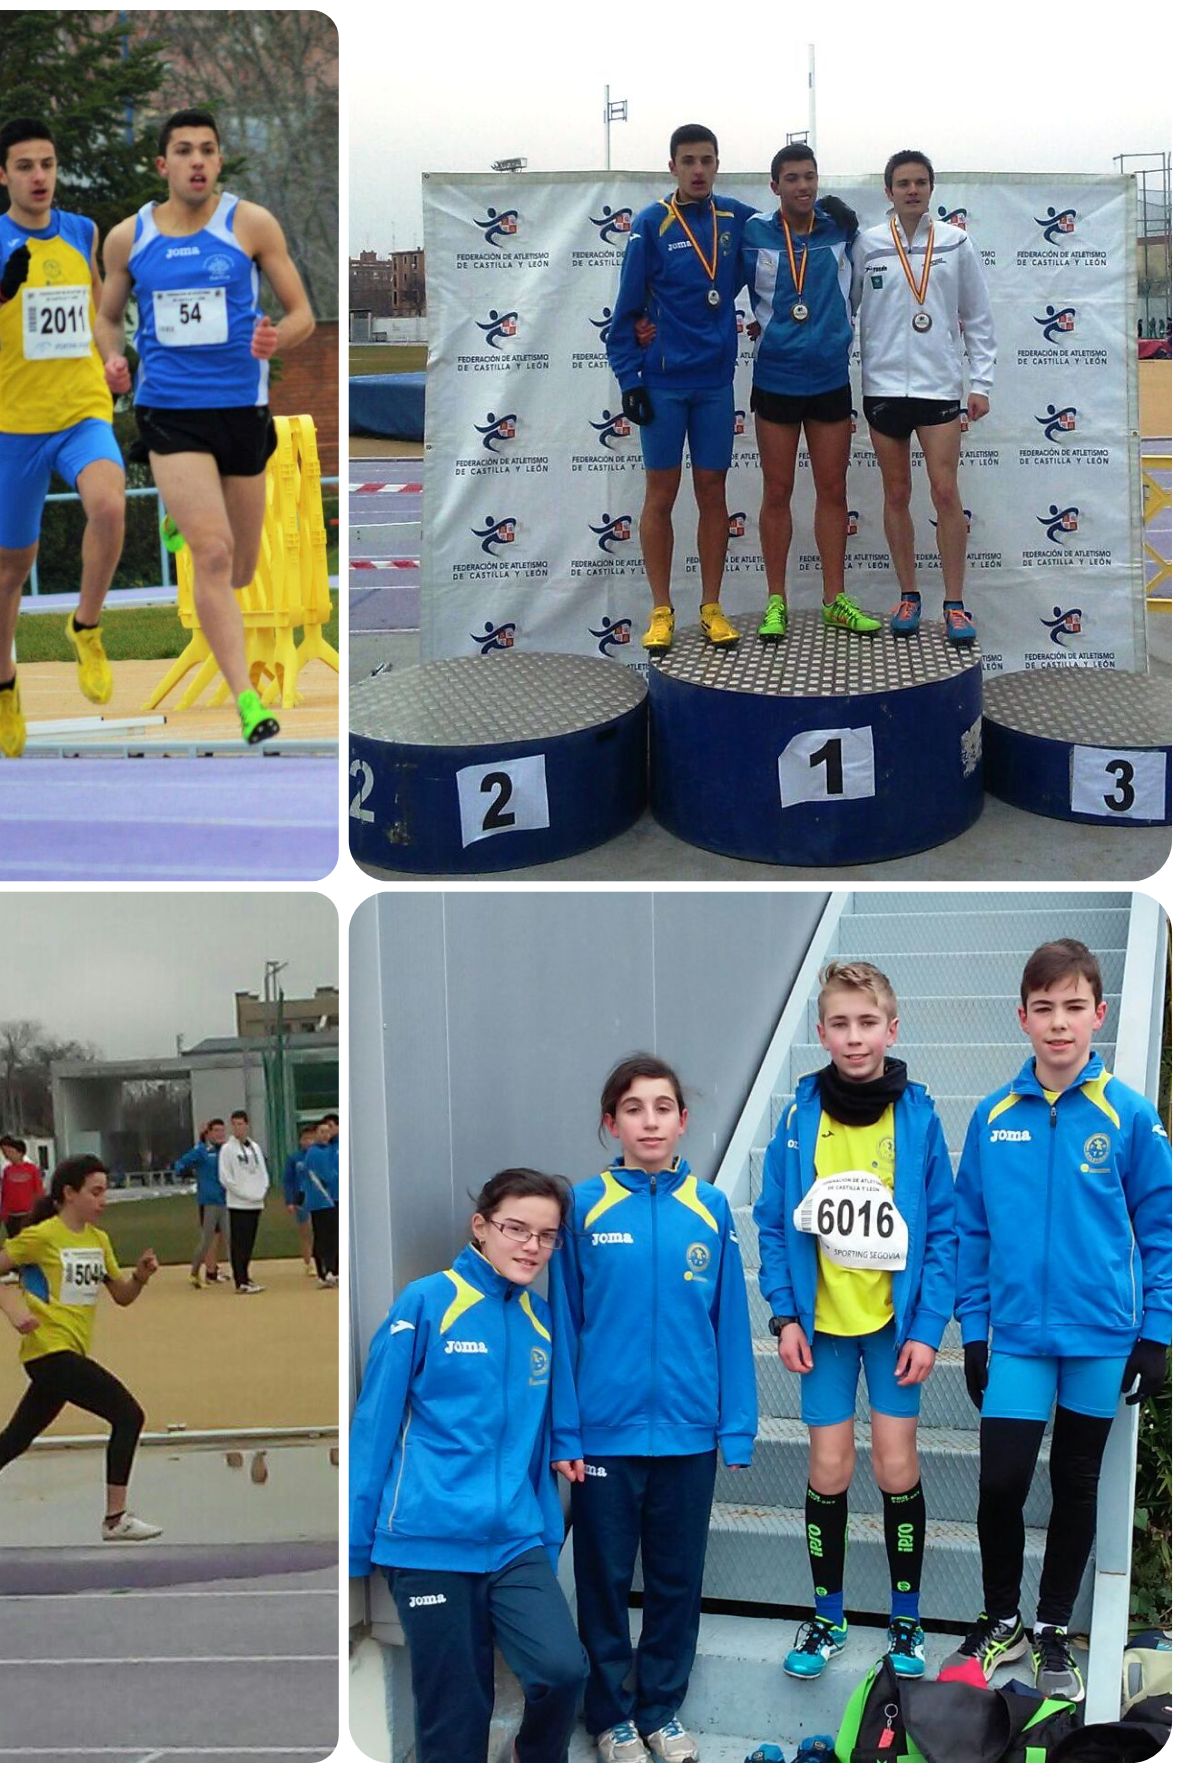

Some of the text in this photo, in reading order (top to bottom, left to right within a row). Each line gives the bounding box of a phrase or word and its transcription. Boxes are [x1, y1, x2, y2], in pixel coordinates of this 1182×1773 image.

[457, 252, 501, 261] FEDERACIÓN
[513, 253, 549, 261] ATLETISMO
[1018, 250, 1059, 258] FEDERACIÓN
[518, 261, 523, 269] Y
[529, 259, 549, 268] LEÓN
[1085, 258, 1106, 266] LEÓN
[180, 302, 202, 325] 54
[458, 355, 500, 364] FEDERACIÓN
[511, 354, 549, 362] ATLETISMO
[1085, 357, 1107, 365] LEÓN
[458, 364, 468, 372] DE
[527, 361, 549, 369] LEÓN
[1020, 448, 1060, 456] FEDERACIÓN
[456, 457, 548, 467] FEDERACIÓN DE ATLETISMO
[471, 466, 510, 475] CASTILLA
[526, 464, 548, 472] LEÓN
[1023, 550, 1062, 558] FEDERACIÓN
[453, 562, 498, 572] FEDERACIÓN
[511, 561, 548, 569] ATLETISMO
[453, 572, 463, 580] DE
[470, 571, 509, 579] CASTILLA
[525, 569, 548, 577] LEÓN
[1025, 652, 1066, 660] FEDERACIÓN
[1093, 660, 1115, 668] LEÓN
[808, 737, 845, 795] 1
[1102, 758, 1137, 813] 3
[479, 771, 516, 831] 2
[817, 1198, 894, 1239] 6016
[584, 1464, 607, 1477] ma
